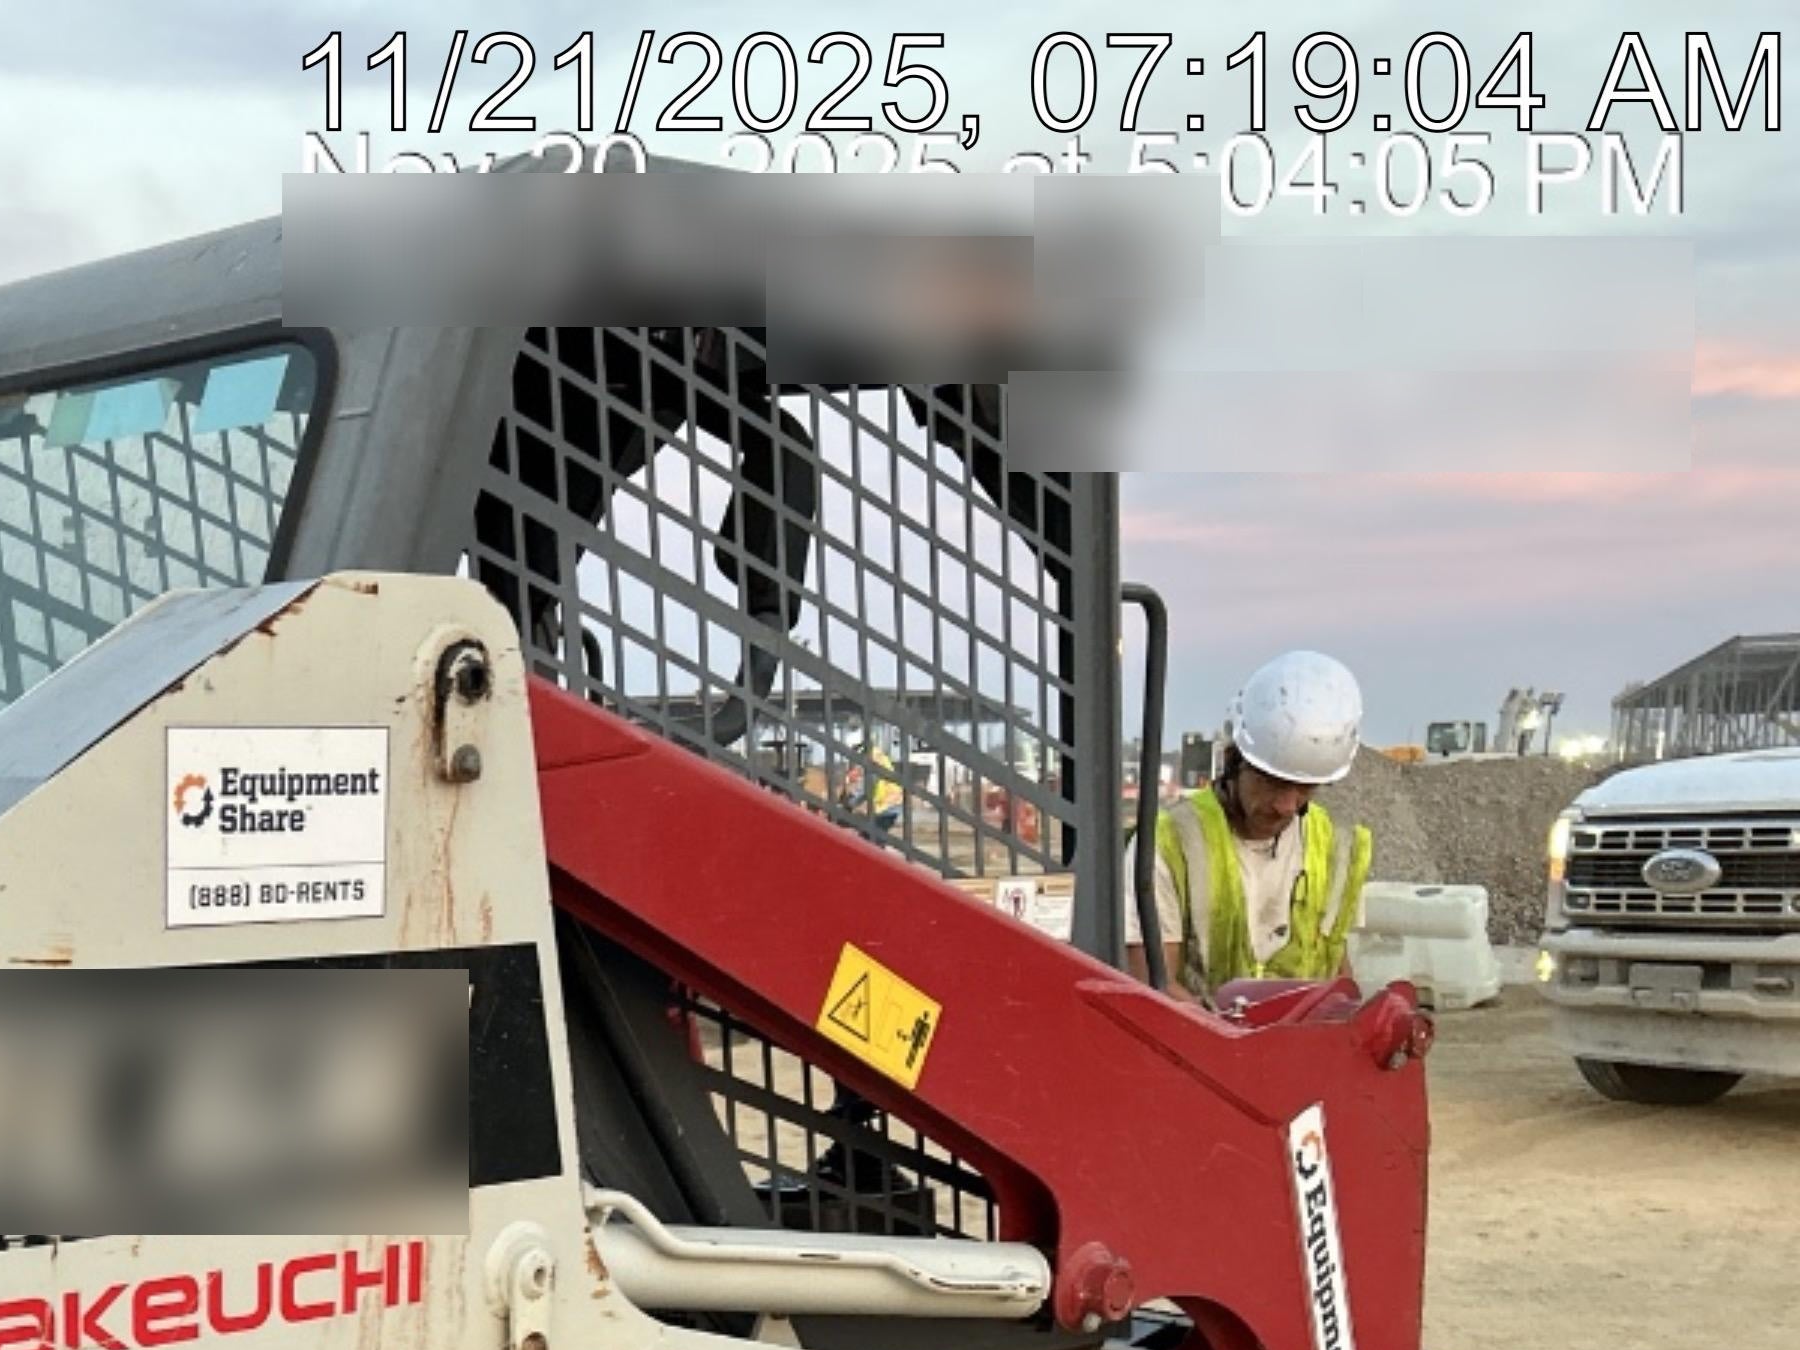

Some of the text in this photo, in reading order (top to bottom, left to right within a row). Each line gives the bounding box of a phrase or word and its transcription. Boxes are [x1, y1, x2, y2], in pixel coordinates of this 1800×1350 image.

[219, 767, 380, 803] Equipment
[218, 804, 306, 833] Share
[189, 883, 251, 910] (888)
